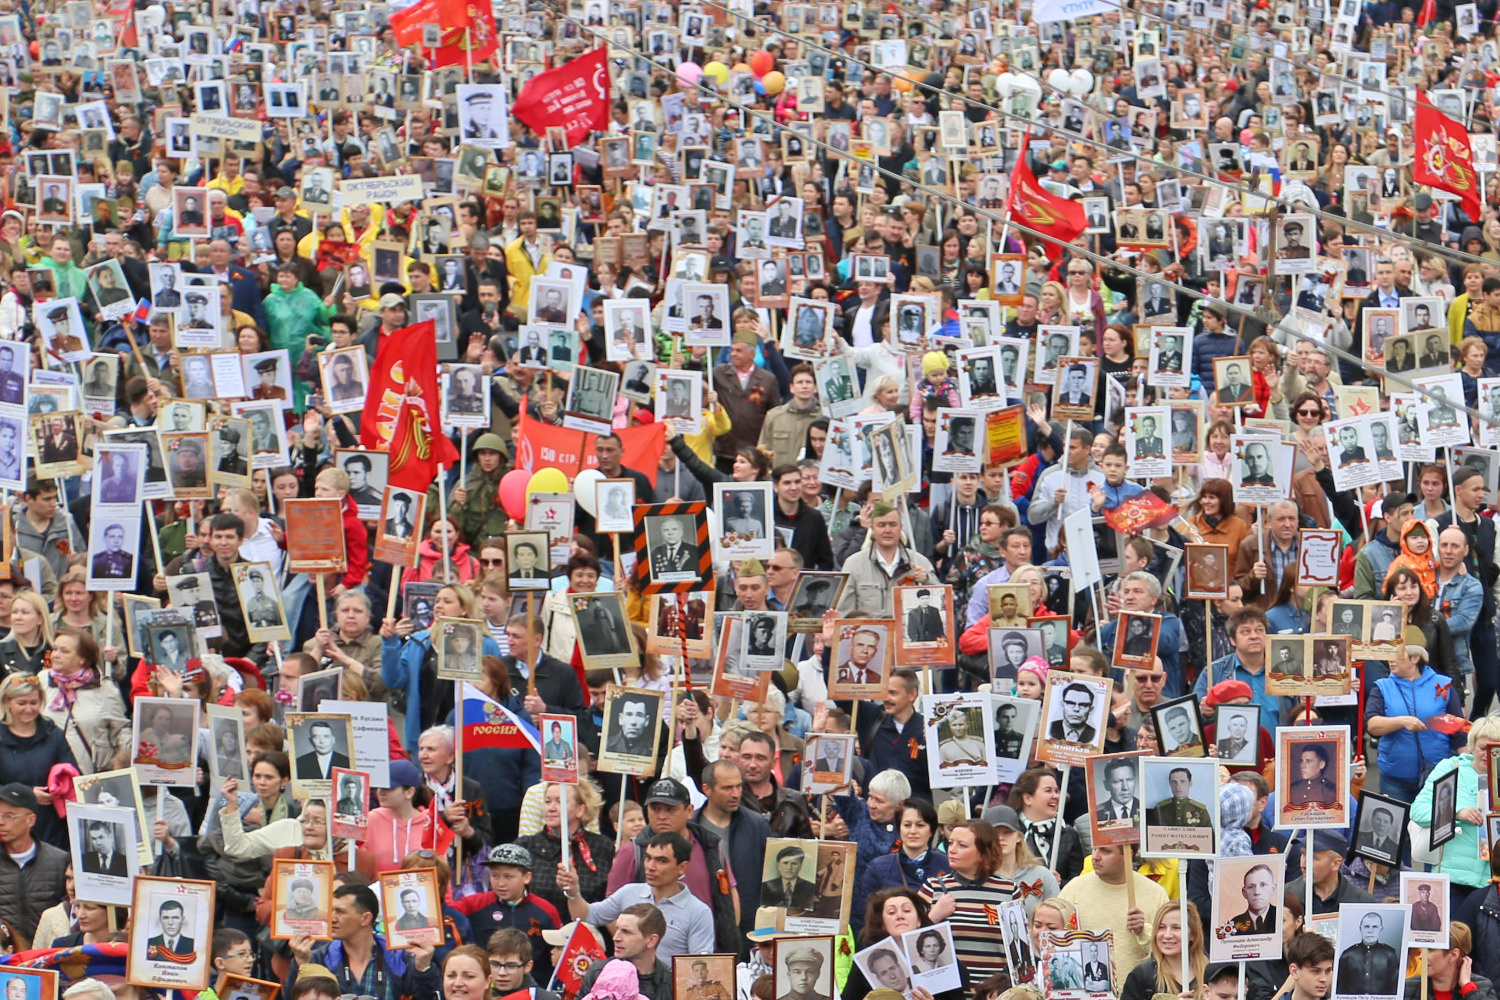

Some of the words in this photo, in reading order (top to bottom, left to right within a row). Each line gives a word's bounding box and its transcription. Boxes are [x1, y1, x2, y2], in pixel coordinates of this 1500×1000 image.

[210, 126, 240, 136] РАЙОН
[346, 178, 415, 192] ОКТЯБРЬСКИЙ
[366, 190, 398, 200] РАЙОН
[472, 724, 518, 736] РОССИЯ
